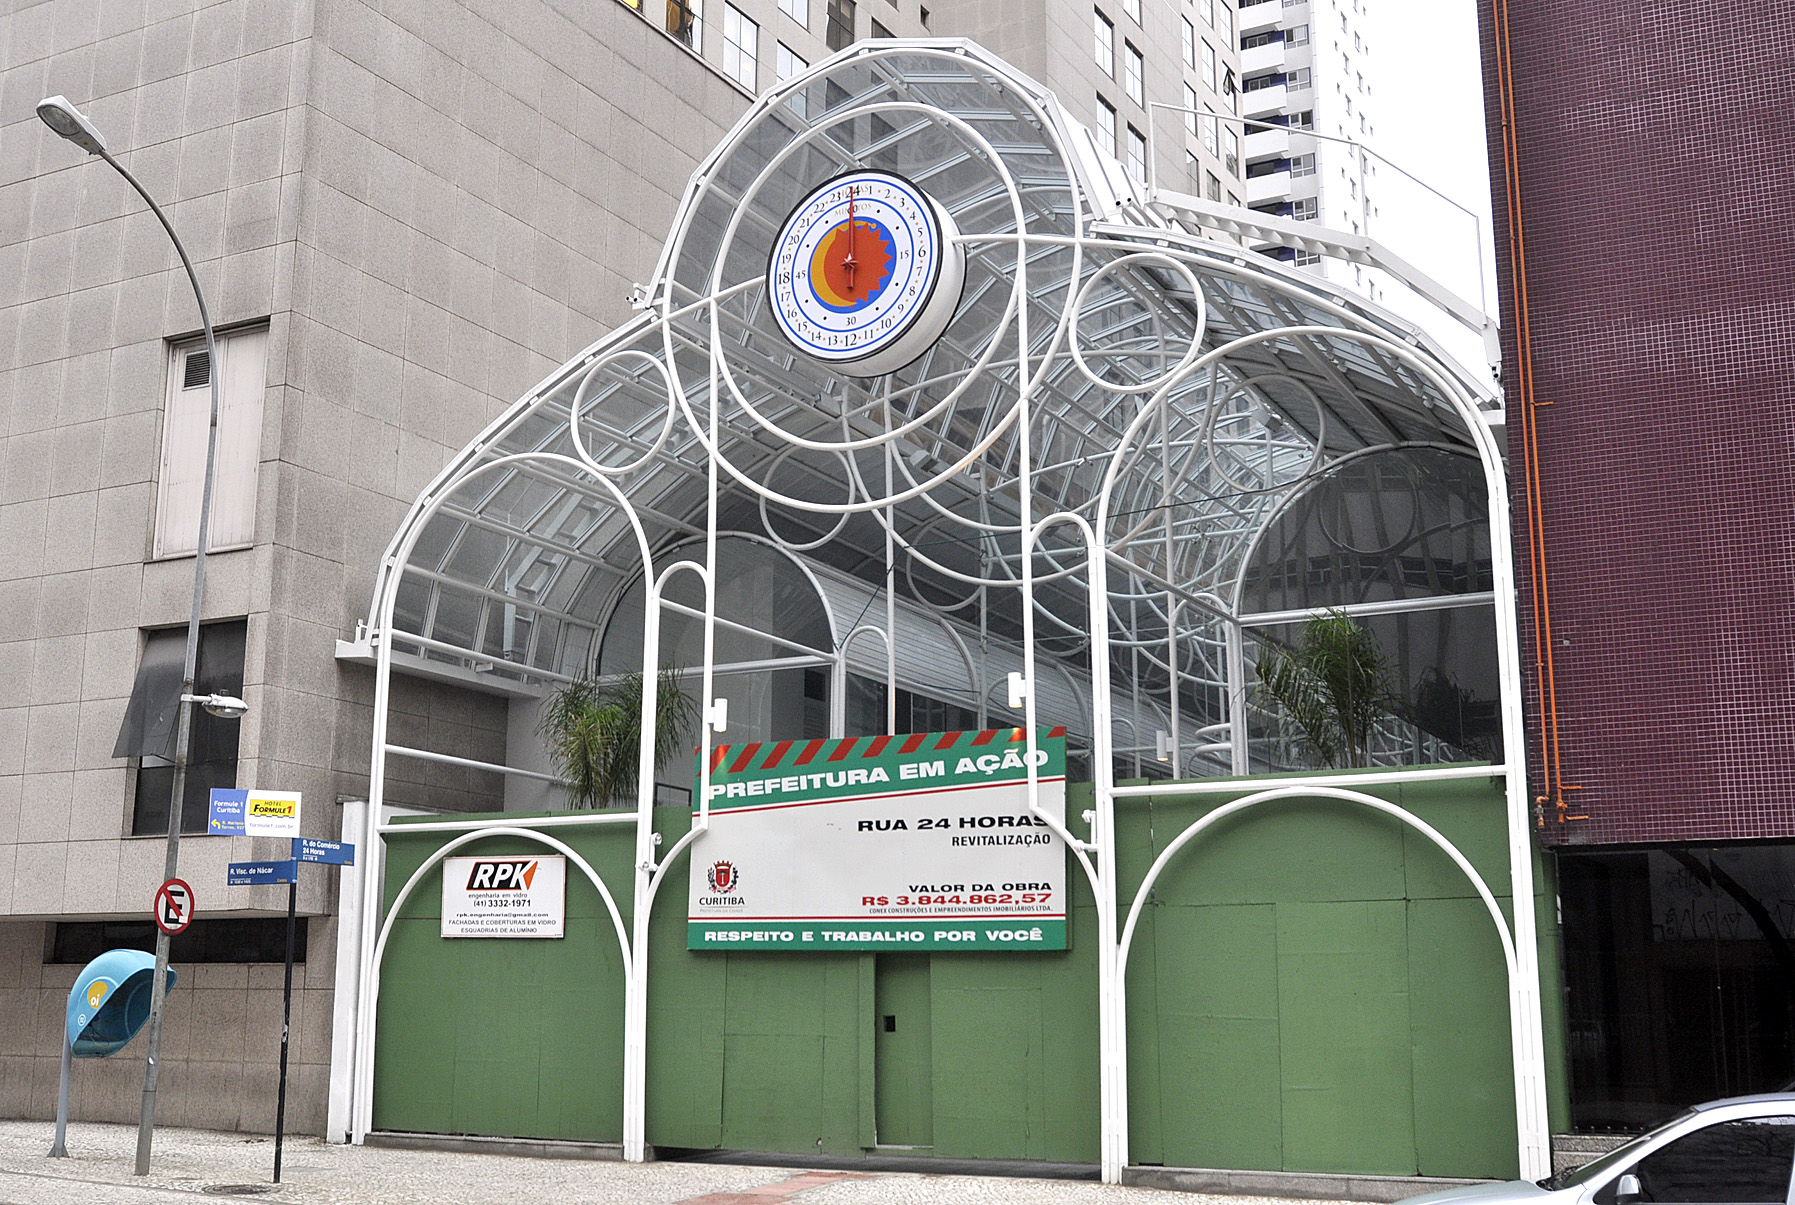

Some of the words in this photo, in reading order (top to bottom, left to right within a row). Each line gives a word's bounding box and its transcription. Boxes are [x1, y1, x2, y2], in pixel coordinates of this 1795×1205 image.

[842, 184, 868, 197] HOAS
[845, 184, 860, 198] 24
[884, 189, 890, 199] 2
[830, 192, 841, 203] 23
[899, 198, 905, 207] 3
[813, 202, 825, 214] 22
[834, 203, 872, 216] MINTOS
[909, 212, 916, 220] 4
[800, 218, 810, 228] 21
[918, 228, 923, 237] 5
[788, 235, 799, 246] 20
[900, 250, 909, 259] 15
[918, 247, 926, 257] 6
[782, 254, 791, 264] 19
[796, 270, 806, 279] 45
[917, 267, 922, 277] 7
[778, 272, 790, 285] 18
[909, 286, 916, 296] 8
[781, 292, 790, 302] 17
[898, 304, 904, 313] 9
[787, 309, 797, 319] 16
[846, 316, 856, 326] 30
[881, 318, 892, 329] 10
[798, 322, 808, 332] 15
[811, 331, 821, 342] 14
[864, 330, 873, 339] 11
[828, 336, 838, 346] 13
[844, 334, 857, 347] 12
[708, 766, 889, 799] PREFEITURA
[899, 760, 945, 780] EM
[954, 748, 1049, 775] AÇÃO
[857, 818, 908, 832] RUA
[917, 817, 950, 830] 24
[958, 814, 1048, 830] HORAS
[317, 841, 340, 850] Comércio
[951, 833, 1051, 848] REVITALIZAÇÃO
[310, 848, 325, 856] Horas
[472, 860, 536, 890] RPK
[908, 884, 965, 893] VALOR
[972, 883, 995, 892] DA
[1001, 882, 1052, 891] OBRA
[699, 897, 745, 905] CURITIBA
[862, 896, 889, 906] R$
[896, 893, 1052, 906] 3.844.862,57
[164, 890, 185, 924] E
[704, 931, 793, 942] RESPEITO
[802, 931, 813, 942] E
[821, 930, 925, 942] TRABALHO
[934, 930, 976, 942] POR
[985, 927, 1043, 941] VOCÊ
[91, 994, 100, 1006] oi
